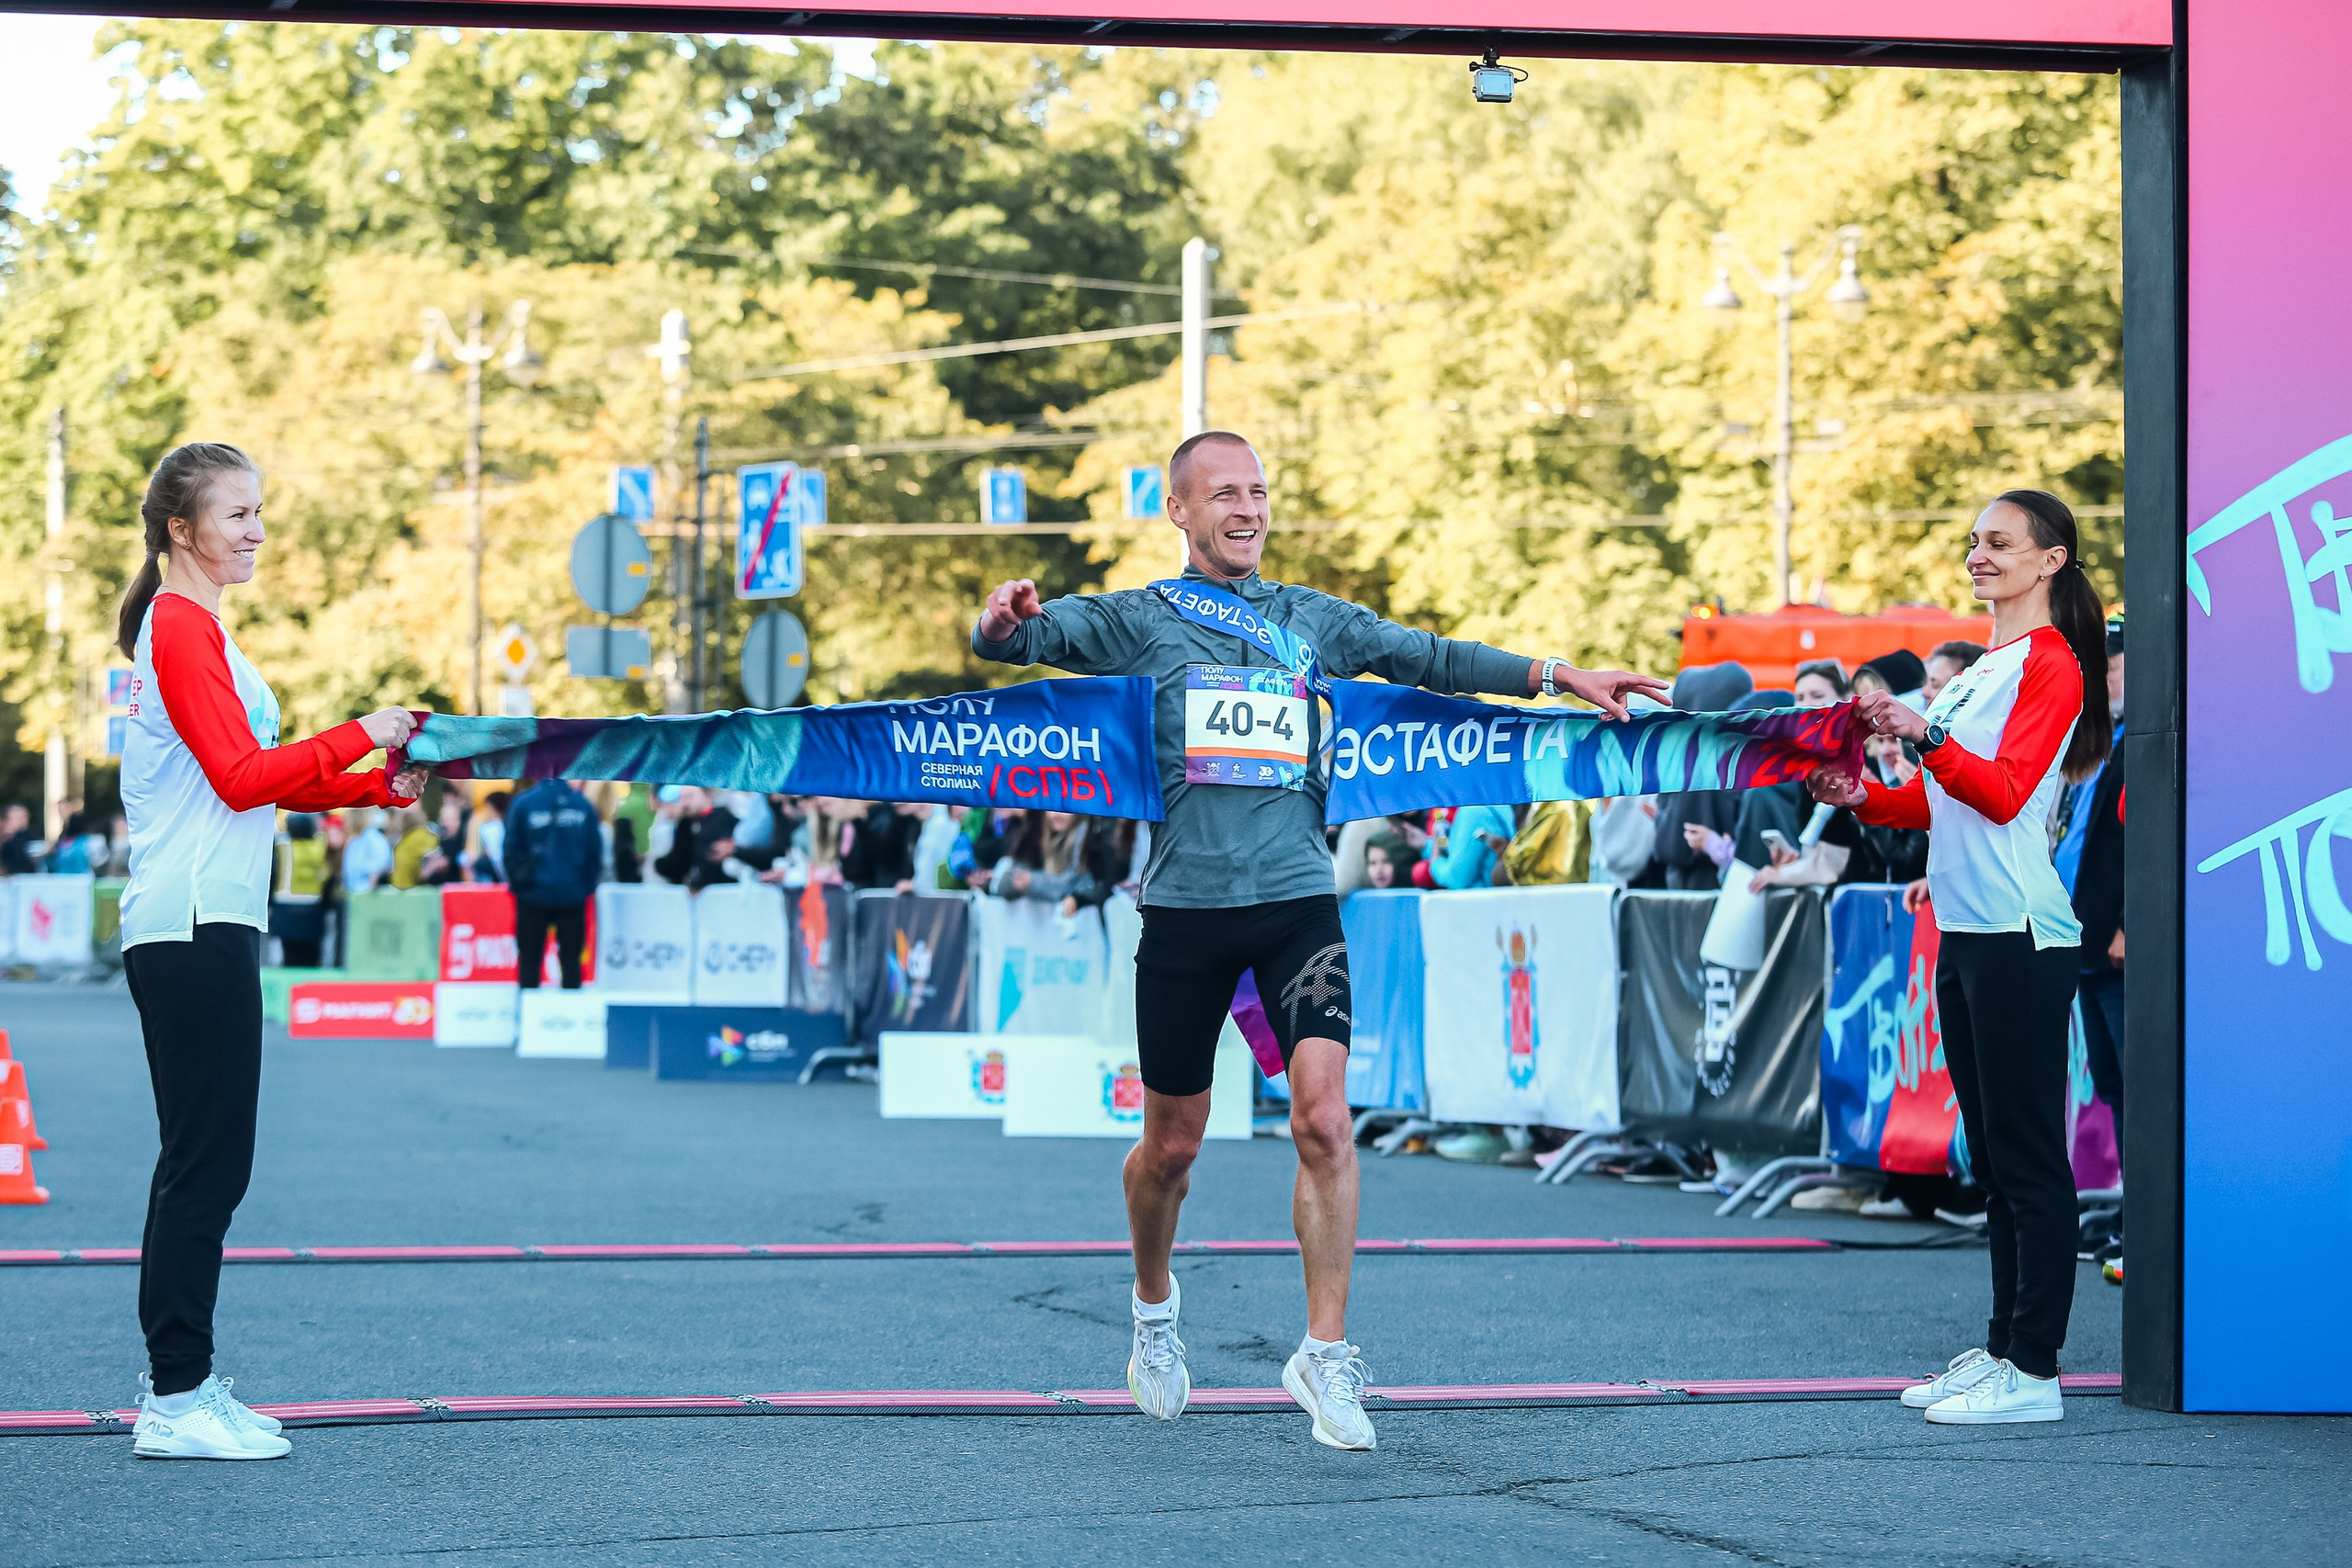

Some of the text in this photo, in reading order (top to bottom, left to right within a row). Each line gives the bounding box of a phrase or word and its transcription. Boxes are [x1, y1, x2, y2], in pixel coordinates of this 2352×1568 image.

[1159, 583, 1274, 645] ЭСТАФЕТА
[1201, 666, 1225, 674] ПОЛУ
[1201, 673, 1244, 683] МАРАФОН
[1205, 700, 1294, 741] 40-4
[891, 720, 1102, 762] МАРАФОН
[1333, 716, 1569, 780] ЭСТАФЕТА
[921, 761, 984, 776] СЕВЕРНАЯ
[921, 776, 981, 790] СТОЛИЦА
